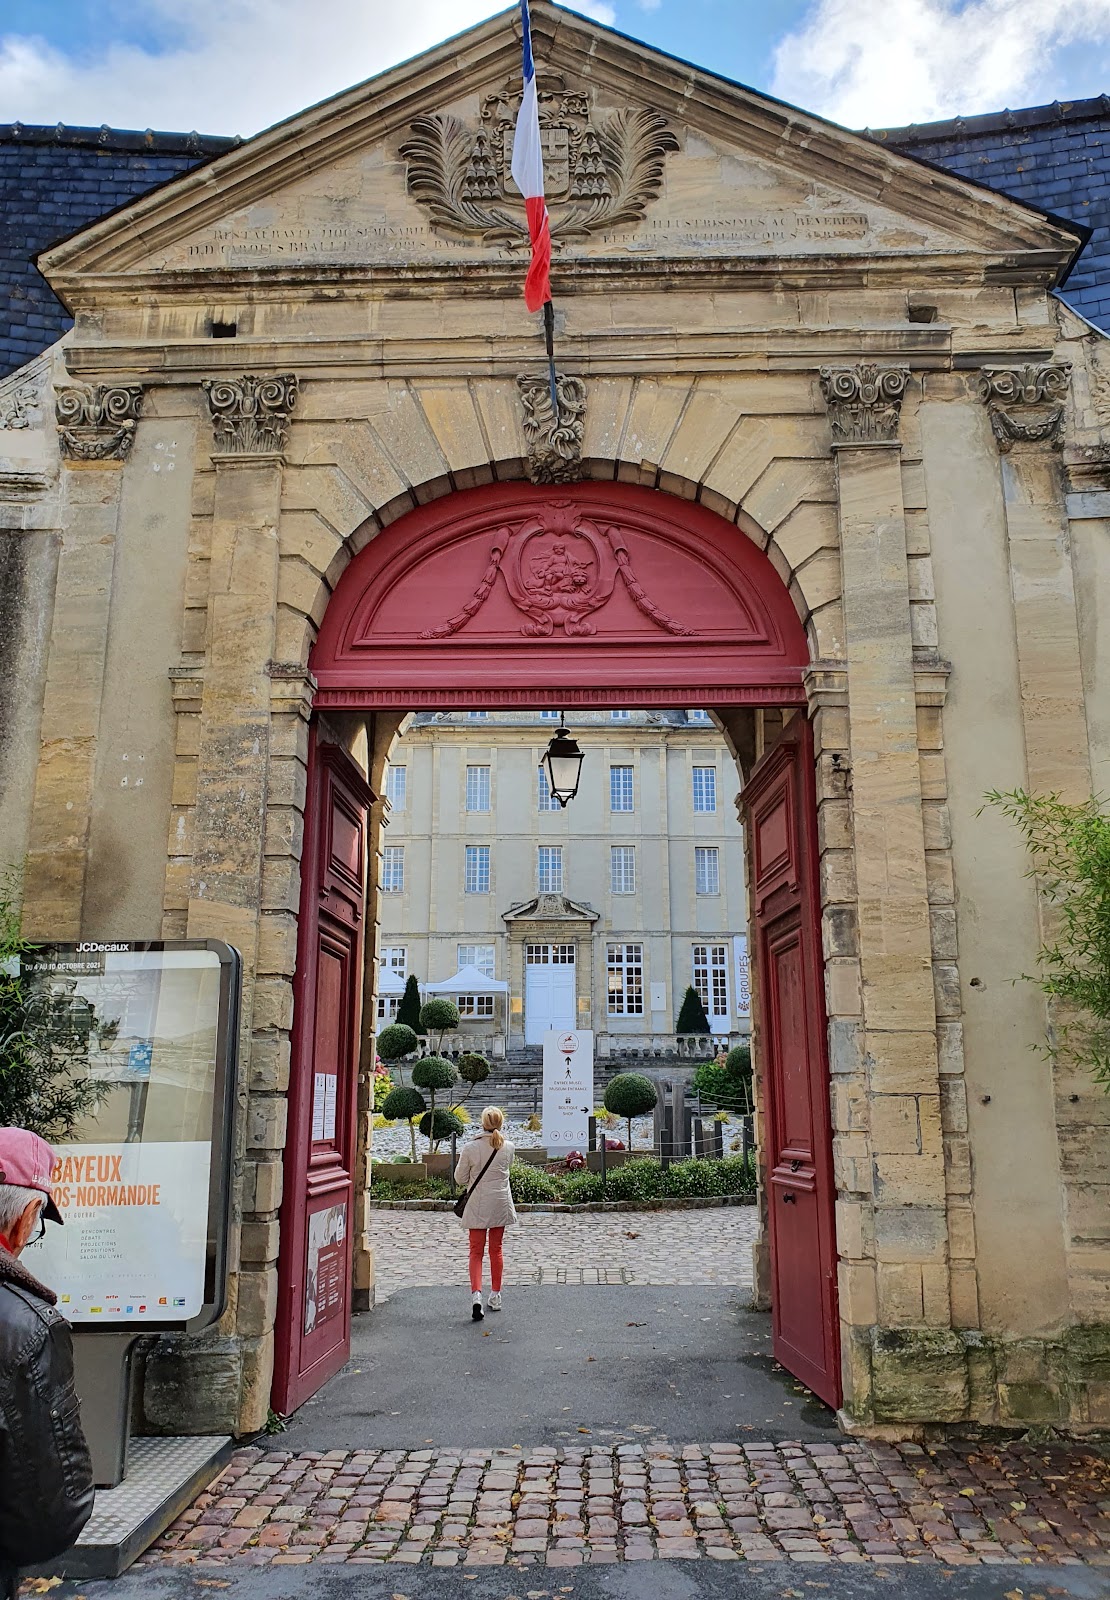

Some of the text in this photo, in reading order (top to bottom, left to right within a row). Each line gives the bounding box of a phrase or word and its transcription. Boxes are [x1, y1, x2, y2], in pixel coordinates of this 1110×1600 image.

[76, 942, 129, 953] JCDecaux
[25, 963, 33, 971] DU
[57, 962, 86, 970] OCTOBRE
[86, 961, 101, 969] 2021
[739, 955, 749, 999] GROUPES
[52, 1155, 122, 1183] BAYEUX
